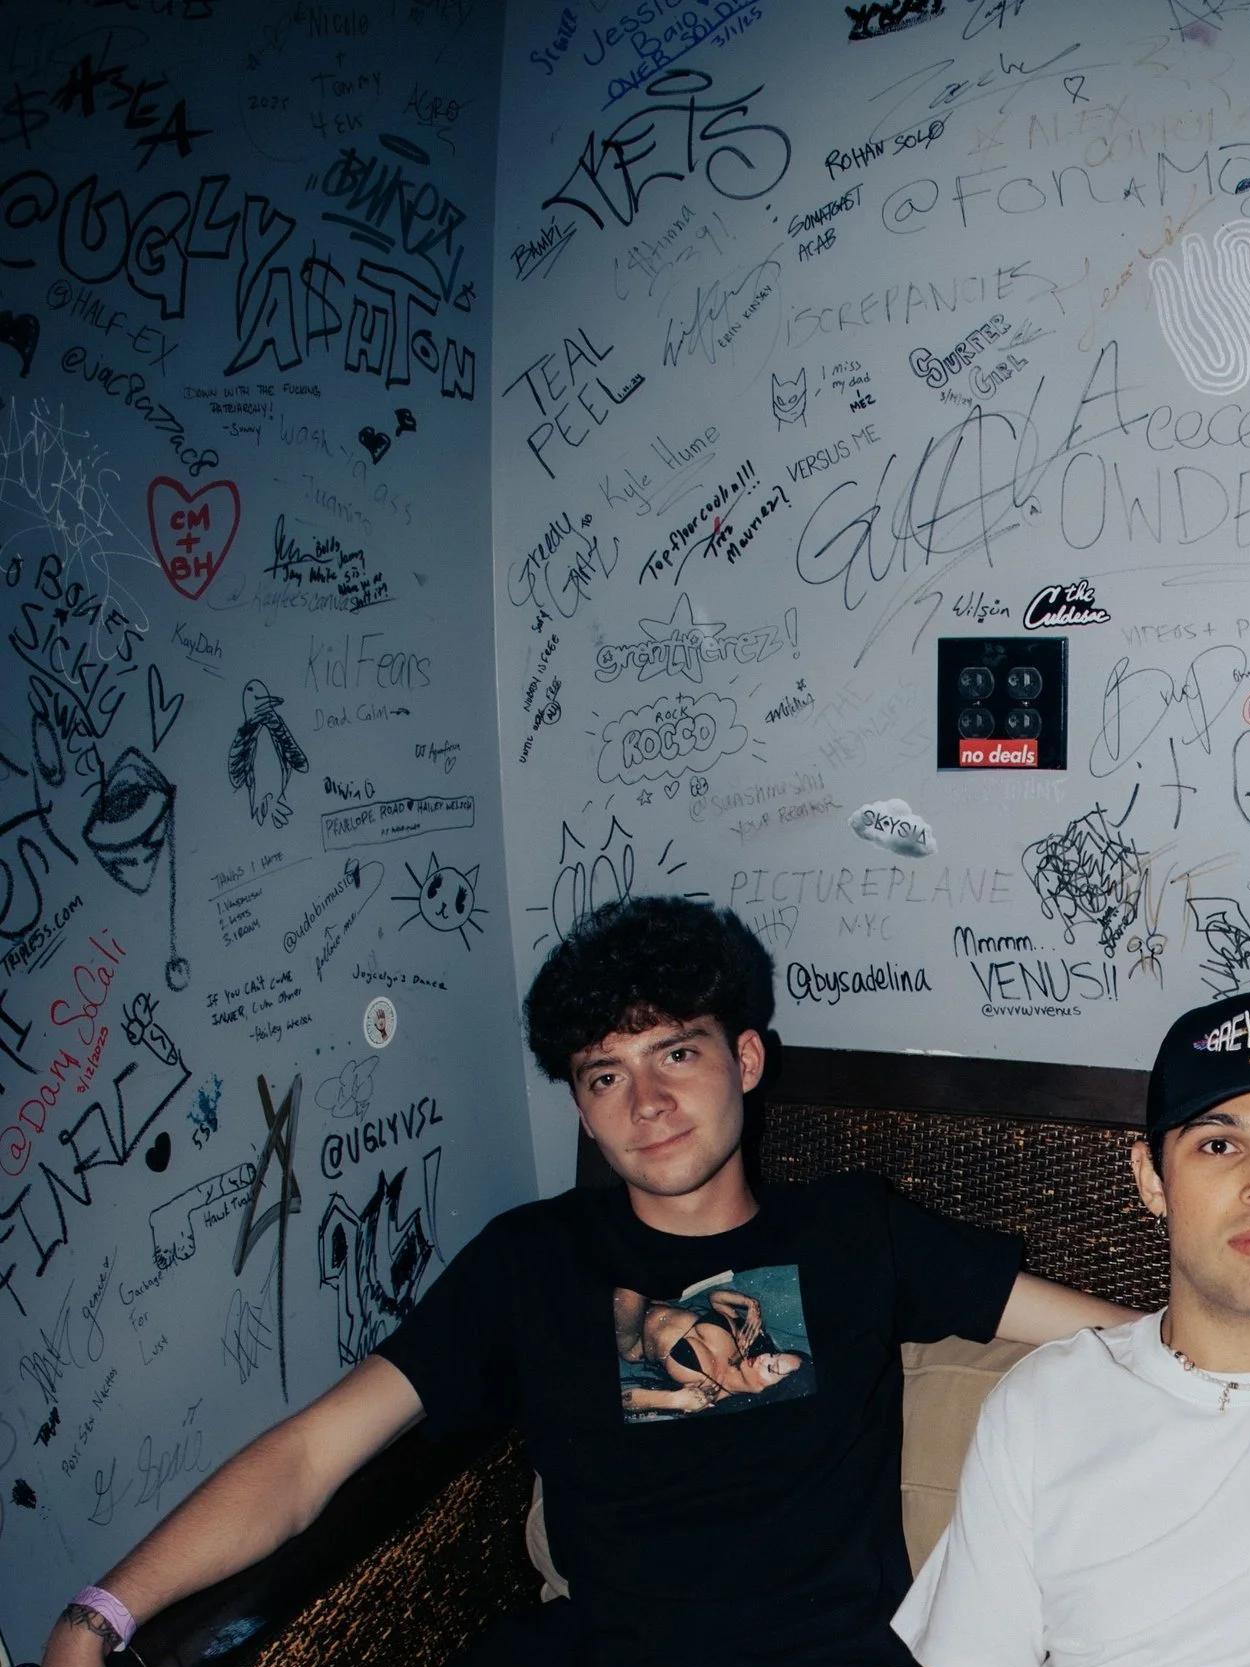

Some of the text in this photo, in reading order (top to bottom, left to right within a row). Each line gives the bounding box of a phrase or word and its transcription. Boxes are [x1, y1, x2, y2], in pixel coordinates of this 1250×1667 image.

[825, 140, 885, 181] ROHAN
[502, 328, 614, 416] TEAL
[908, 312, 1012, 390] SURFER
[183, 386, 218, 400] DOWN
[223, 387, 250, 397] WITH
[256, 385, 275, 397] THE
[968, 352, 1030, 400] GIRL
[526, 373, 646, 479] PEEL
[786, 423, 881, 483] VERSUS ME
[171, 509, 211, 531] CM
[171, 556, 216, 581] BH
[1023, 587, 1111, 630] Culdesac
[1064, 580, 1096, 603] the
[304, 632, 433, 689] Kid Fears
[622, 713, 717, 768] ROCCO
[961, 743, 1036, 766] no deals
[379, 801, 406, 820] ROAD
[786, 961, 933, 1007] @bysadelina
